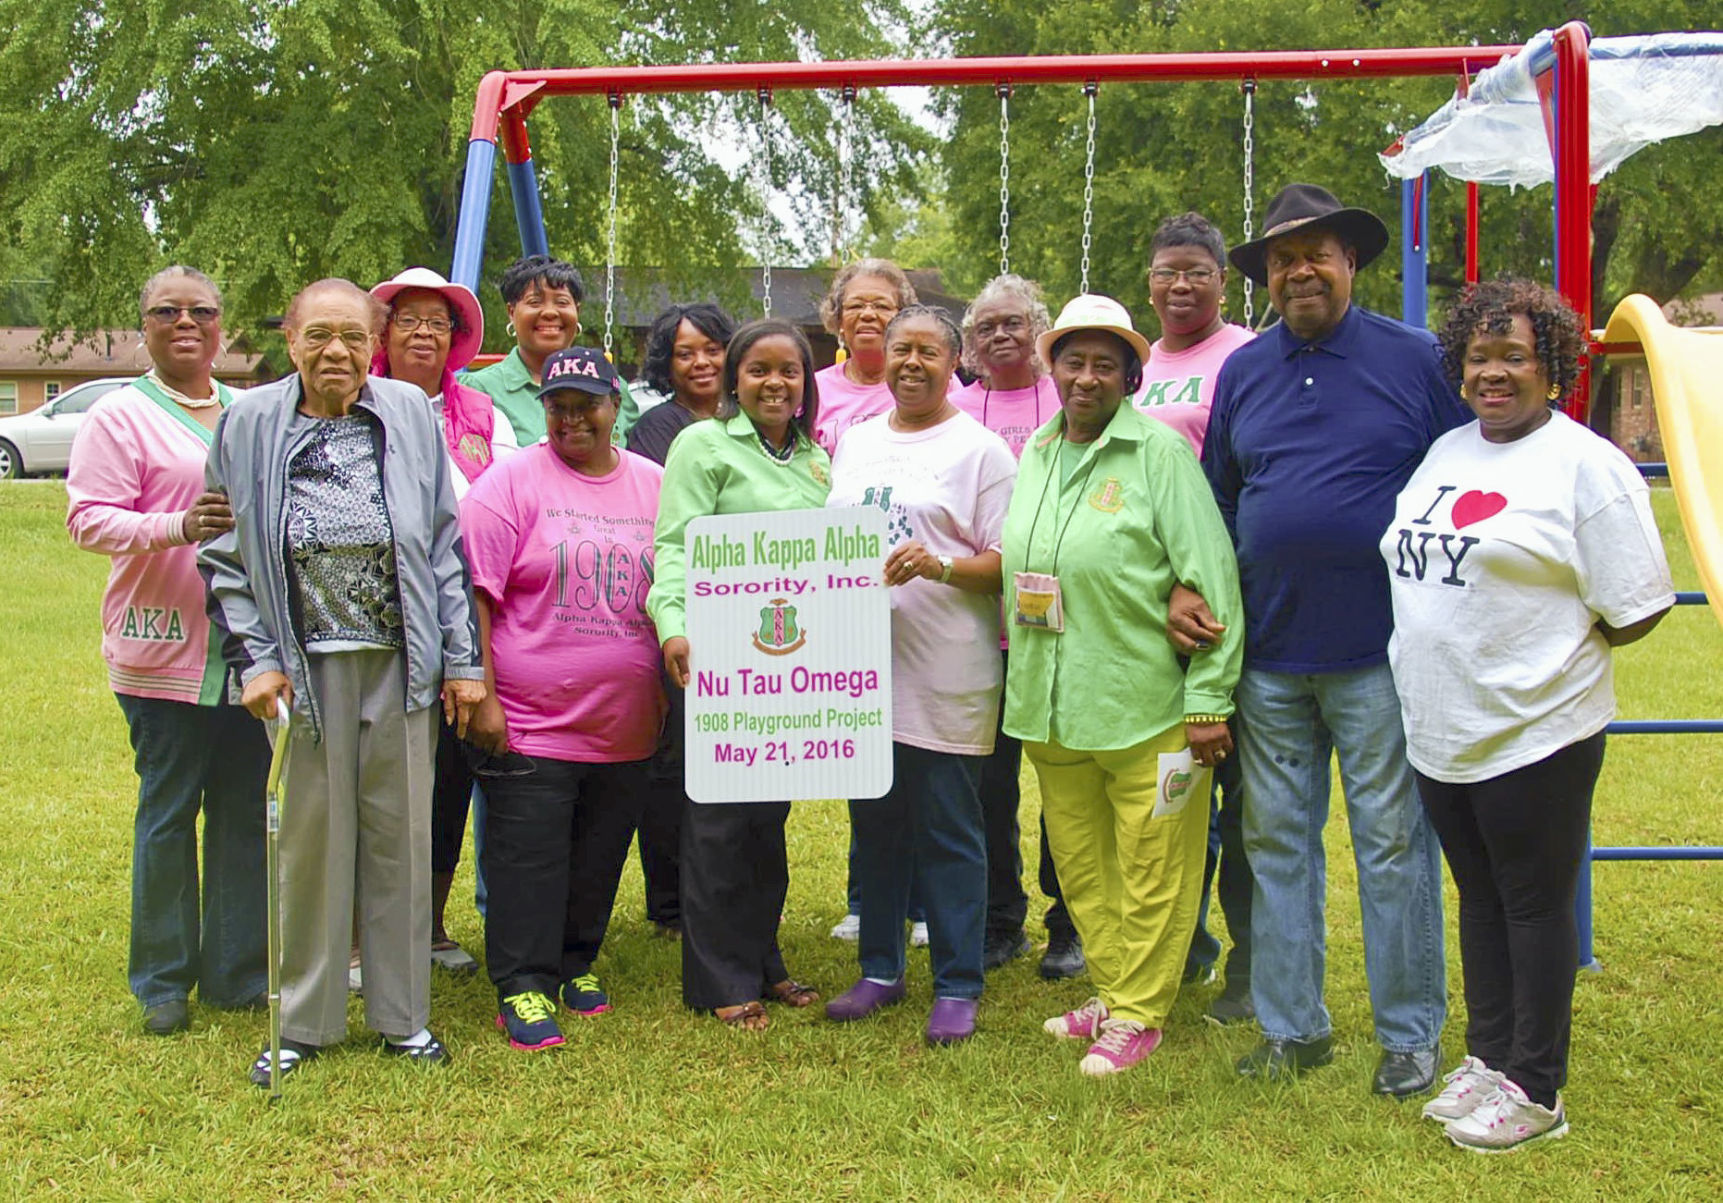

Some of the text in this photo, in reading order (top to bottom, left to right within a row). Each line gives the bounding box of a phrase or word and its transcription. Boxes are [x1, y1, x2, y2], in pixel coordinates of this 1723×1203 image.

[547, 358, 600, 380] AKA
[1128, 377, 1203, 406] KA
[564, 509, 600, 524] Started
[1411, 485, 1457, 525] I
[692, 525, 880, 574] Alpha Kappa Alpha
[1396, 529, 1480, 587] NY
[694, 574, 879, 597] Sorority, Inc.
[122, 606, 184, 641] AKA
[697, 664, 879, 699] Nu Tau Omega
[695, 708, 883, 736] 1908 Playground Project
[714, 738, 856, 767] May 21, 2016
